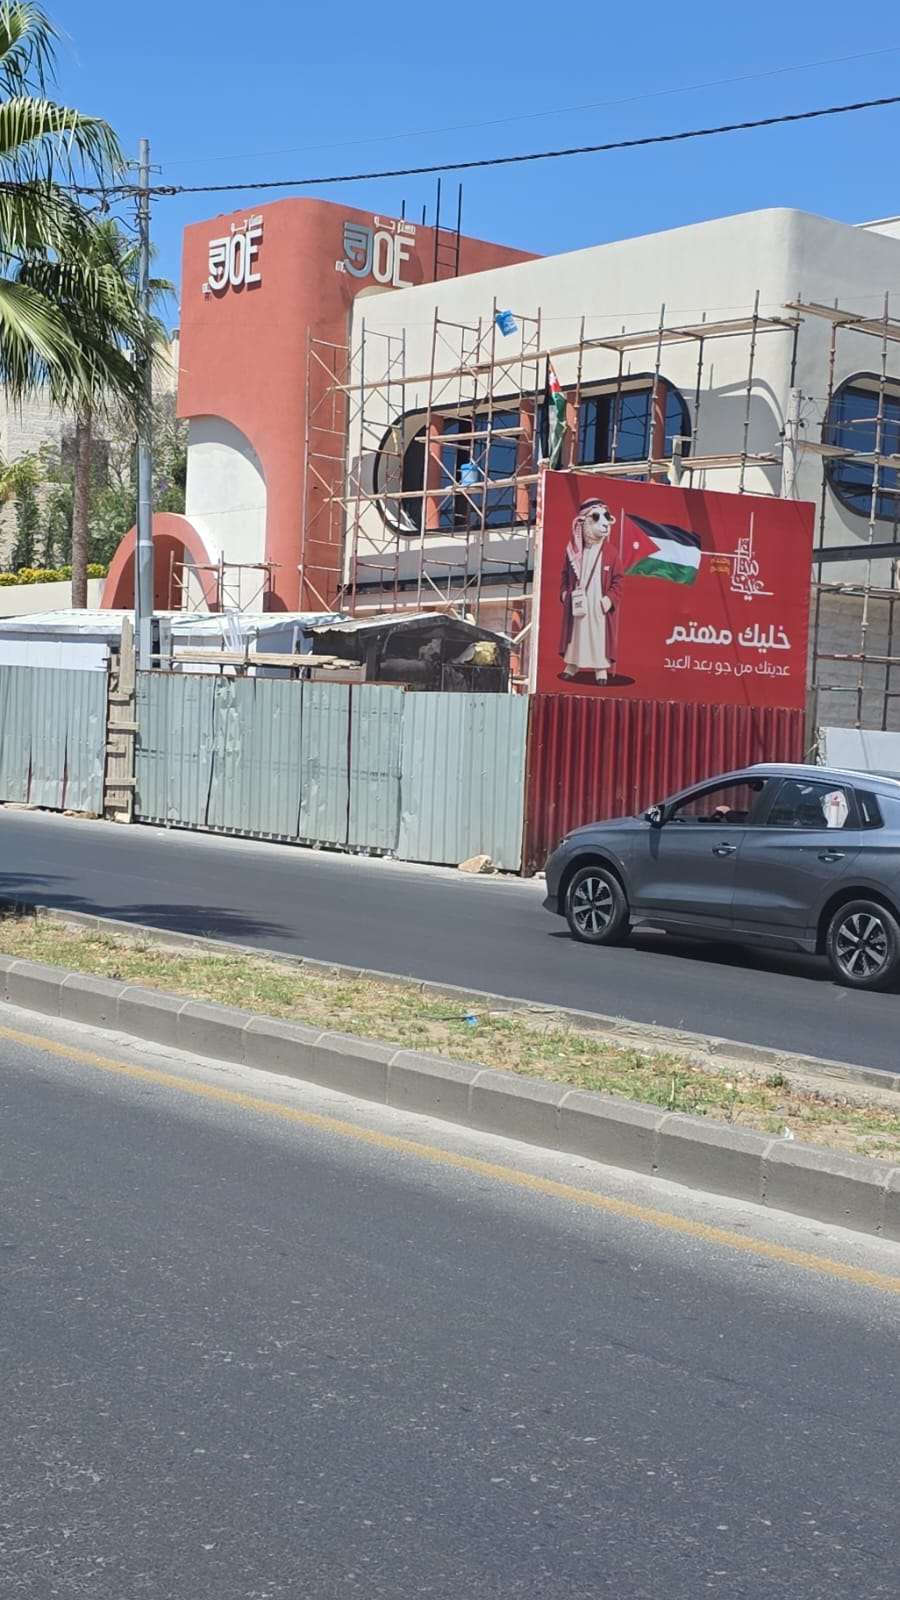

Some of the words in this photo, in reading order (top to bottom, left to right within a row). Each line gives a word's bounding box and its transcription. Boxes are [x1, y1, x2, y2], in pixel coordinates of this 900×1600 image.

[665, 621, 733, 645] مهتم
[738, 623, 791, 653] خليك
[663, 655, 691, 672] العيد
[693, 659, 713, 674] بعد
[714, 661, 732, 675] جو
[734, 662, 753, 677] من
[754, 660, 791, 678] عديتك
